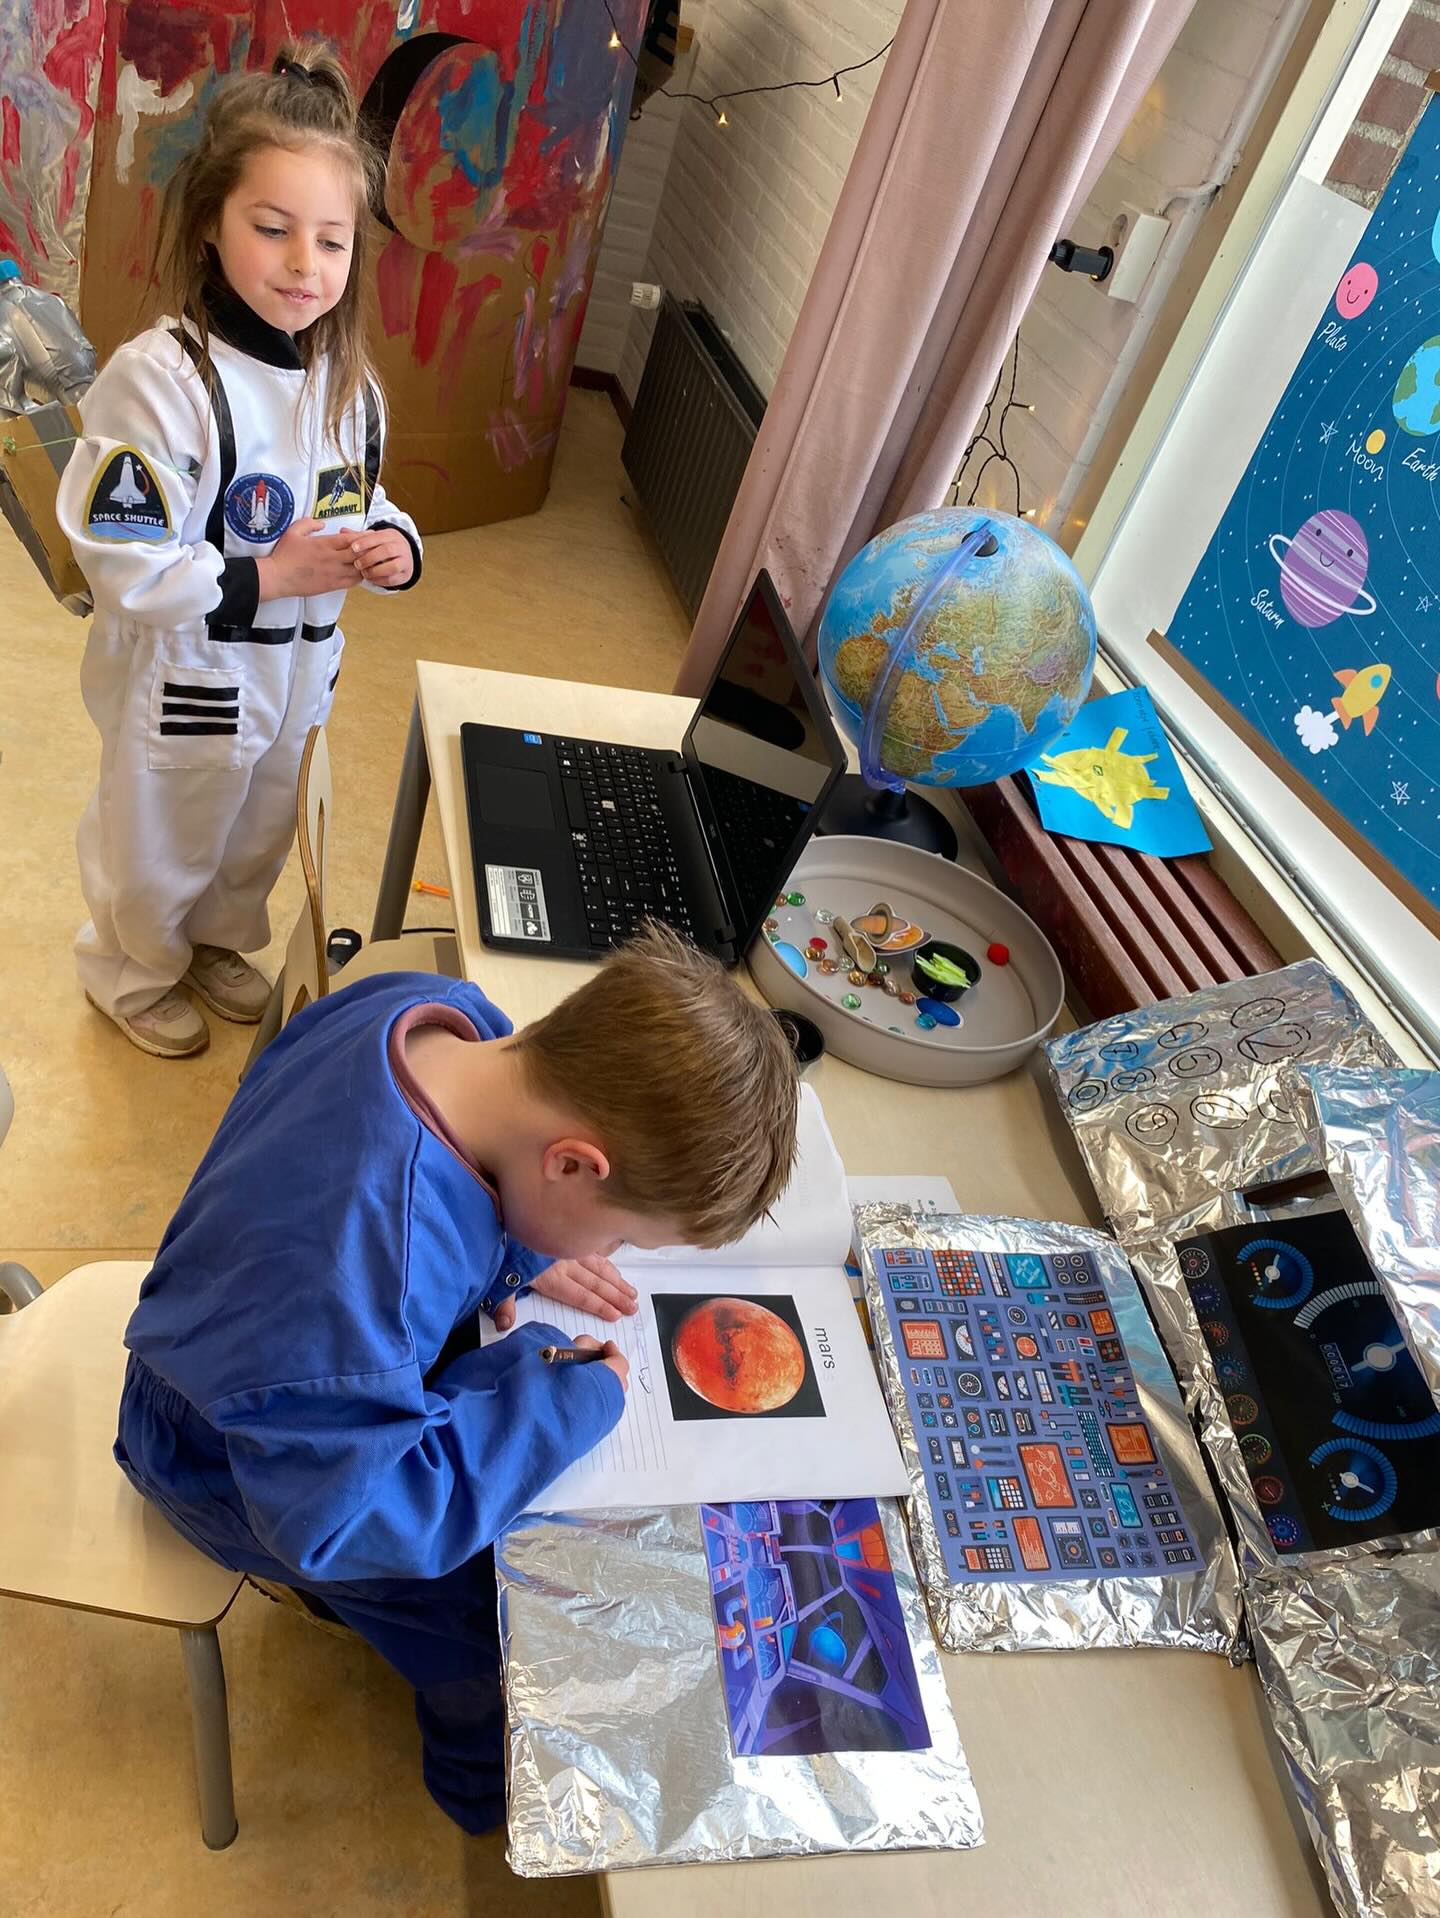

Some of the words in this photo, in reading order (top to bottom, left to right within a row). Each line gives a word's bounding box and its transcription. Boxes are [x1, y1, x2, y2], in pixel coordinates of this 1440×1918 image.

[1317, 321, 1348, 351] Pluto
[1345, 439, 1385, 481] Moon
[1401, 447, 1440, 482] Earth
[92, 512, 122, 522] SPACE
[124, 512, 165, 527] SHUTTLE
[1250, 588, 1285, 630] Saturn
[1245, 1029, 1303, 1058] 2
[1176, 1053, 1212, 1071] 5
[1117, 1072, 1147, 1086] 8
[814, 1327, 836, 1369] mars
